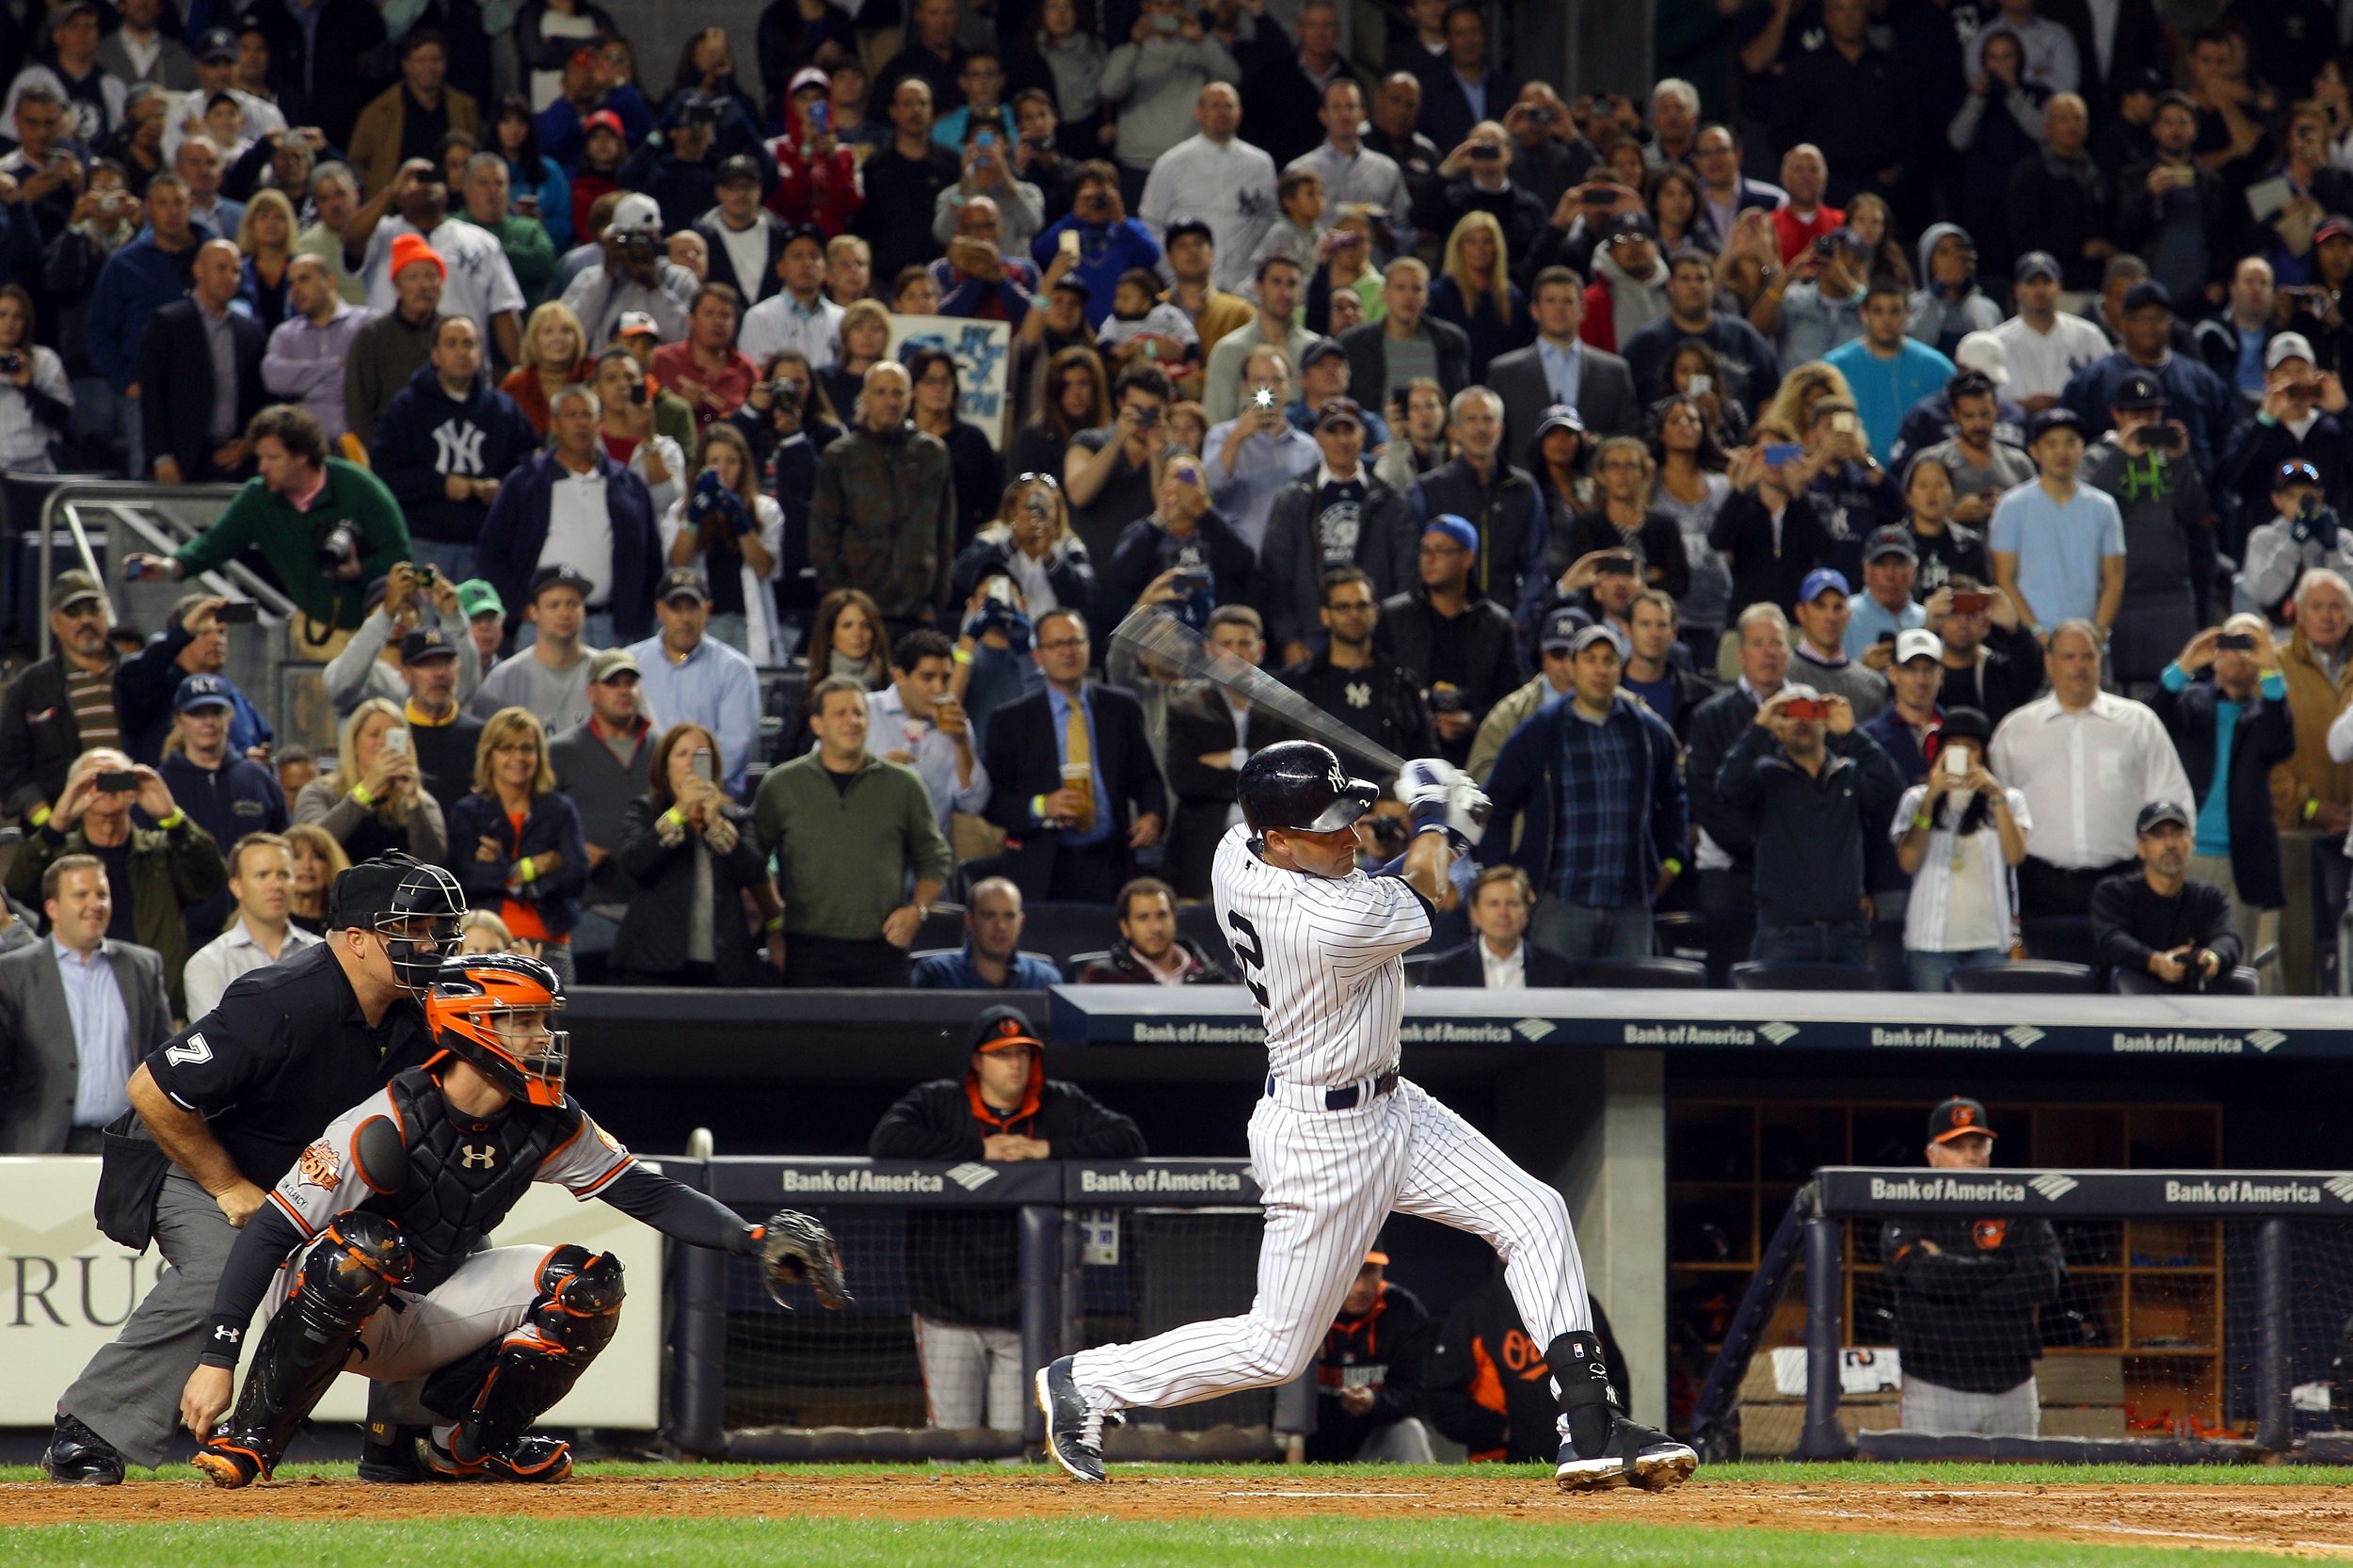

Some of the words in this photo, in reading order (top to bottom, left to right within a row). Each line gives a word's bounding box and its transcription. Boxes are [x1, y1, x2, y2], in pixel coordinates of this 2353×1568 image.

[432, 418, 488, 474] NY
[1359, 799, 1371, 808] 2
[1227, 909, 1271, 1009] 2
[1133, 1022, 1176, 1043] Bank
[1177, 1022, 1196, 1043] of
[1196, 1022, 1267, 1043] America
[1422, 1022, 1442, 1043] of
[1442, 1022, 1512, 1043] America
[1625, 1024, 1667, 1044] Bank
[1667, 1024, 1687, 1045] of
[1687, 1025, 1756, 1046] America
[1871, 1027, 1914, 1047] Bank
[1914, 1028, 1934, 1048] of
[1934, 1028, 2002, 1049] America
[2113, 1032, 2155, 1052] Bank
[2155, 1033, 2174, 1052] of
[2174, 1033, 2243, 1054] America
[165, 1032, 214, 1067] 7
[301, 1159, 329, 1185] 60
[782, 1169, 836, 1192] Bank
[836, 1170, 858, 1192] of
[858, 1169, 944, 1192] America
[1081, 1170, 1133, 1192] Bank
[1133, 1169, 1157, 1192] of
[1157, 1168, 1241, 1192] America
[1870, 1177, 1921, 1200] Bank
[1921, 1177, 1944, 1201] of
[1944, 1178, 2025, 1202] America
[2166, 1180, 2217, 1203] Bank
[2217, 1180, 2239, 1204] of
[2239, 1180, 2321, 1204] America
[7, 1256, 167, 1327] RU
